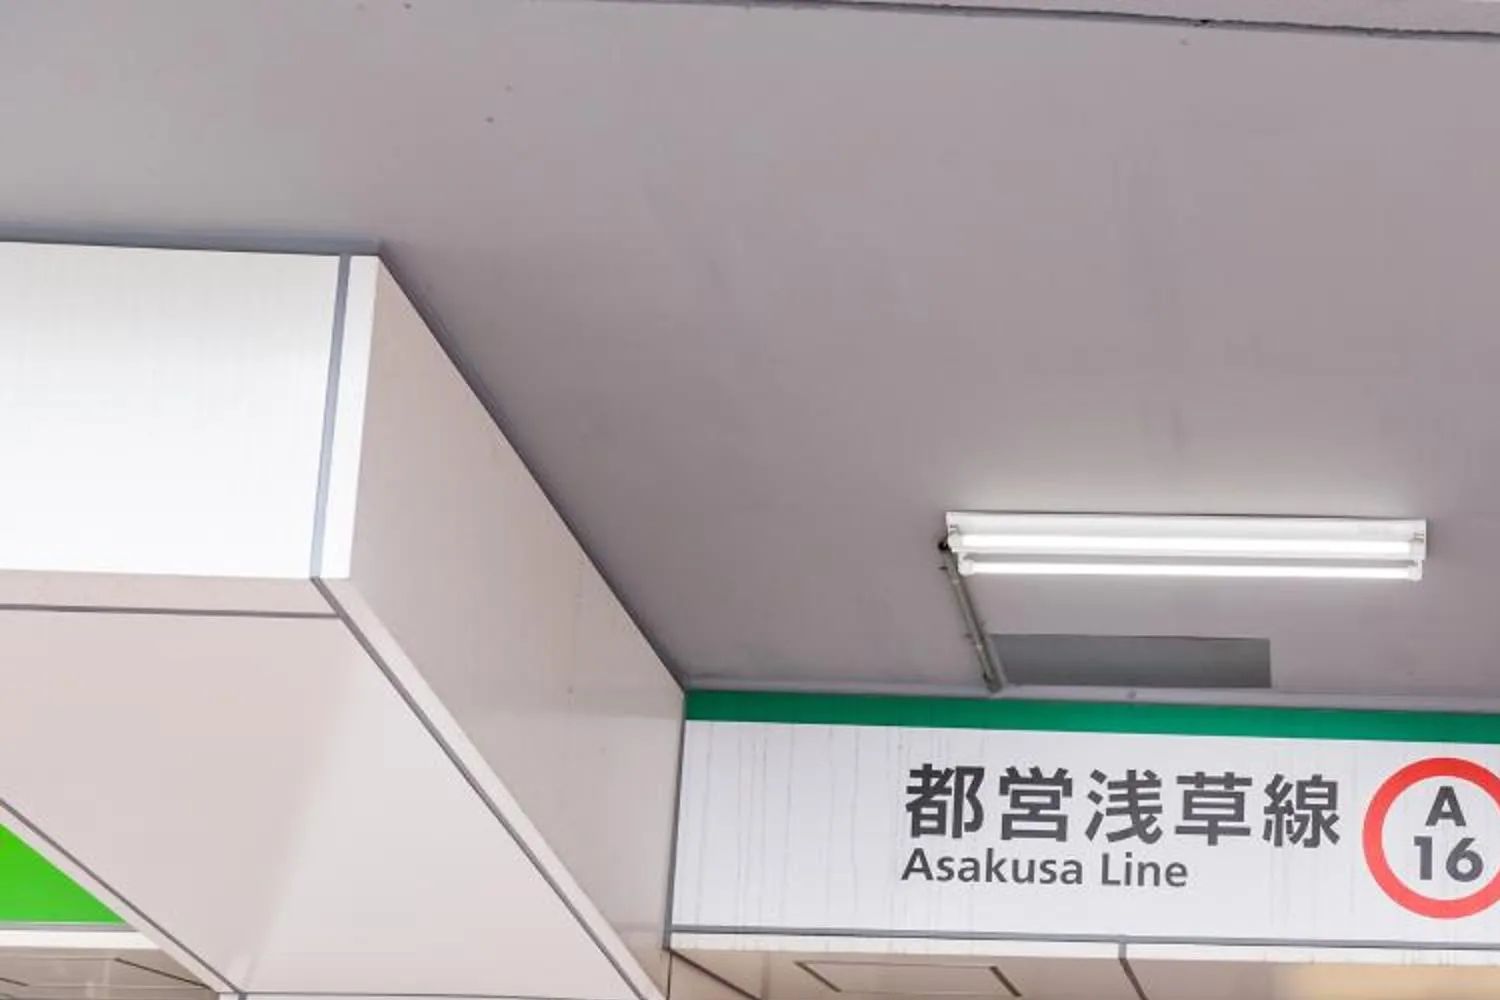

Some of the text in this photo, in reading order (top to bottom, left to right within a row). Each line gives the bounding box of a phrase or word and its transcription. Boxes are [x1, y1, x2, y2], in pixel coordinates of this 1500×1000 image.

[904, 762, 1340, 849] 都営浅草線
[1424, 785, 1467, 828] A
[901, 848, 1189, 888] Asakusa Line
[1413, 837, 1485, 882] 16
